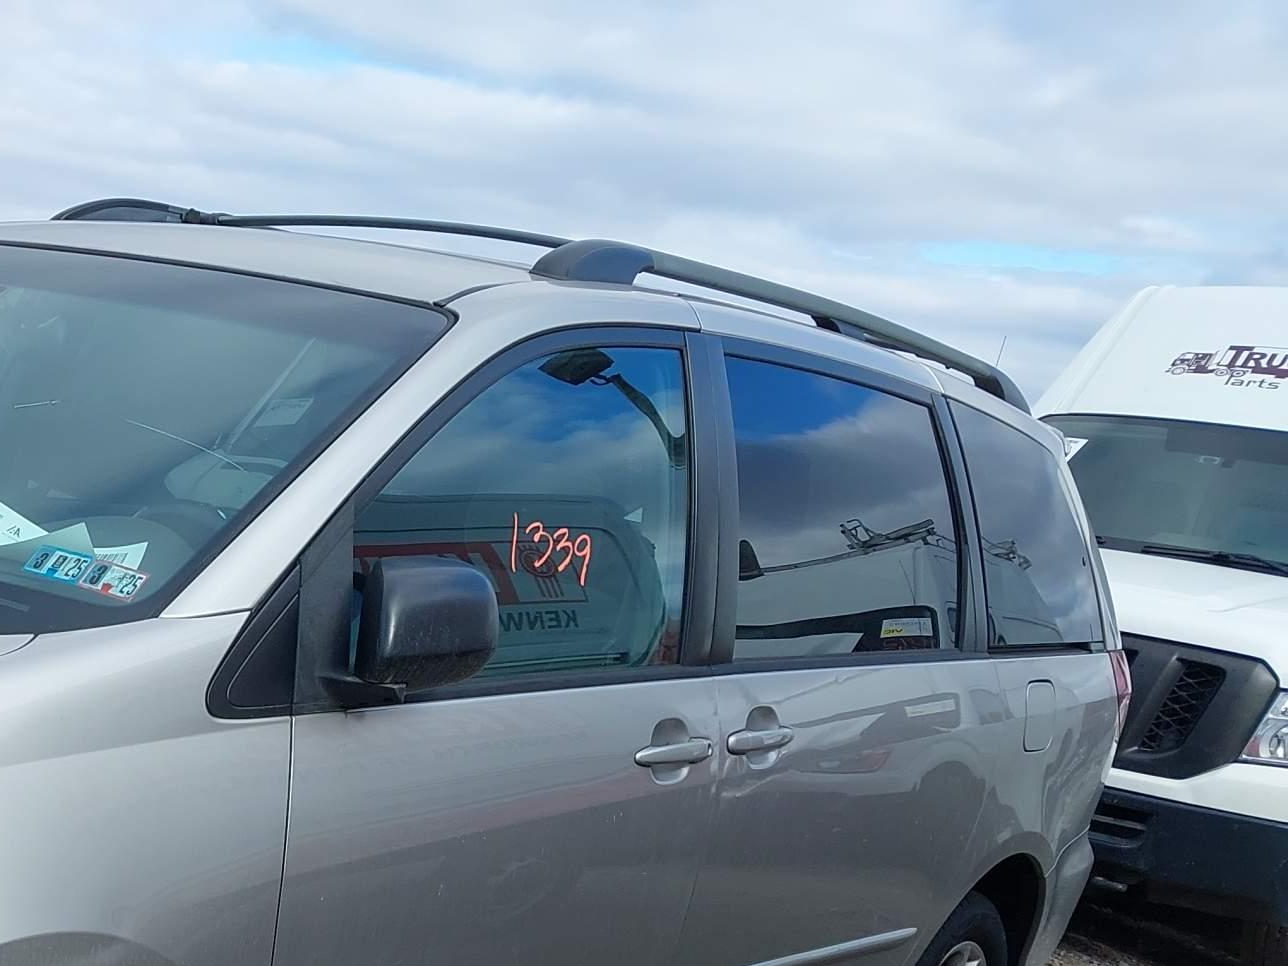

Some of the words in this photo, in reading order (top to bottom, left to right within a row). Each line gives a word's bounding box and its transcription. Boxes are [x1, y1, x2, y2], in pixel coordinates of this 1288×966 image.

[1226, 345, 1288, 370] TRU
[511, 511, 592, 587] 1339
[33, 552, 49, 569] 3
[65, 556, 90, 579] 25
[89, 565, 107, 585] 3
[119, 572, 143, 596] 25
